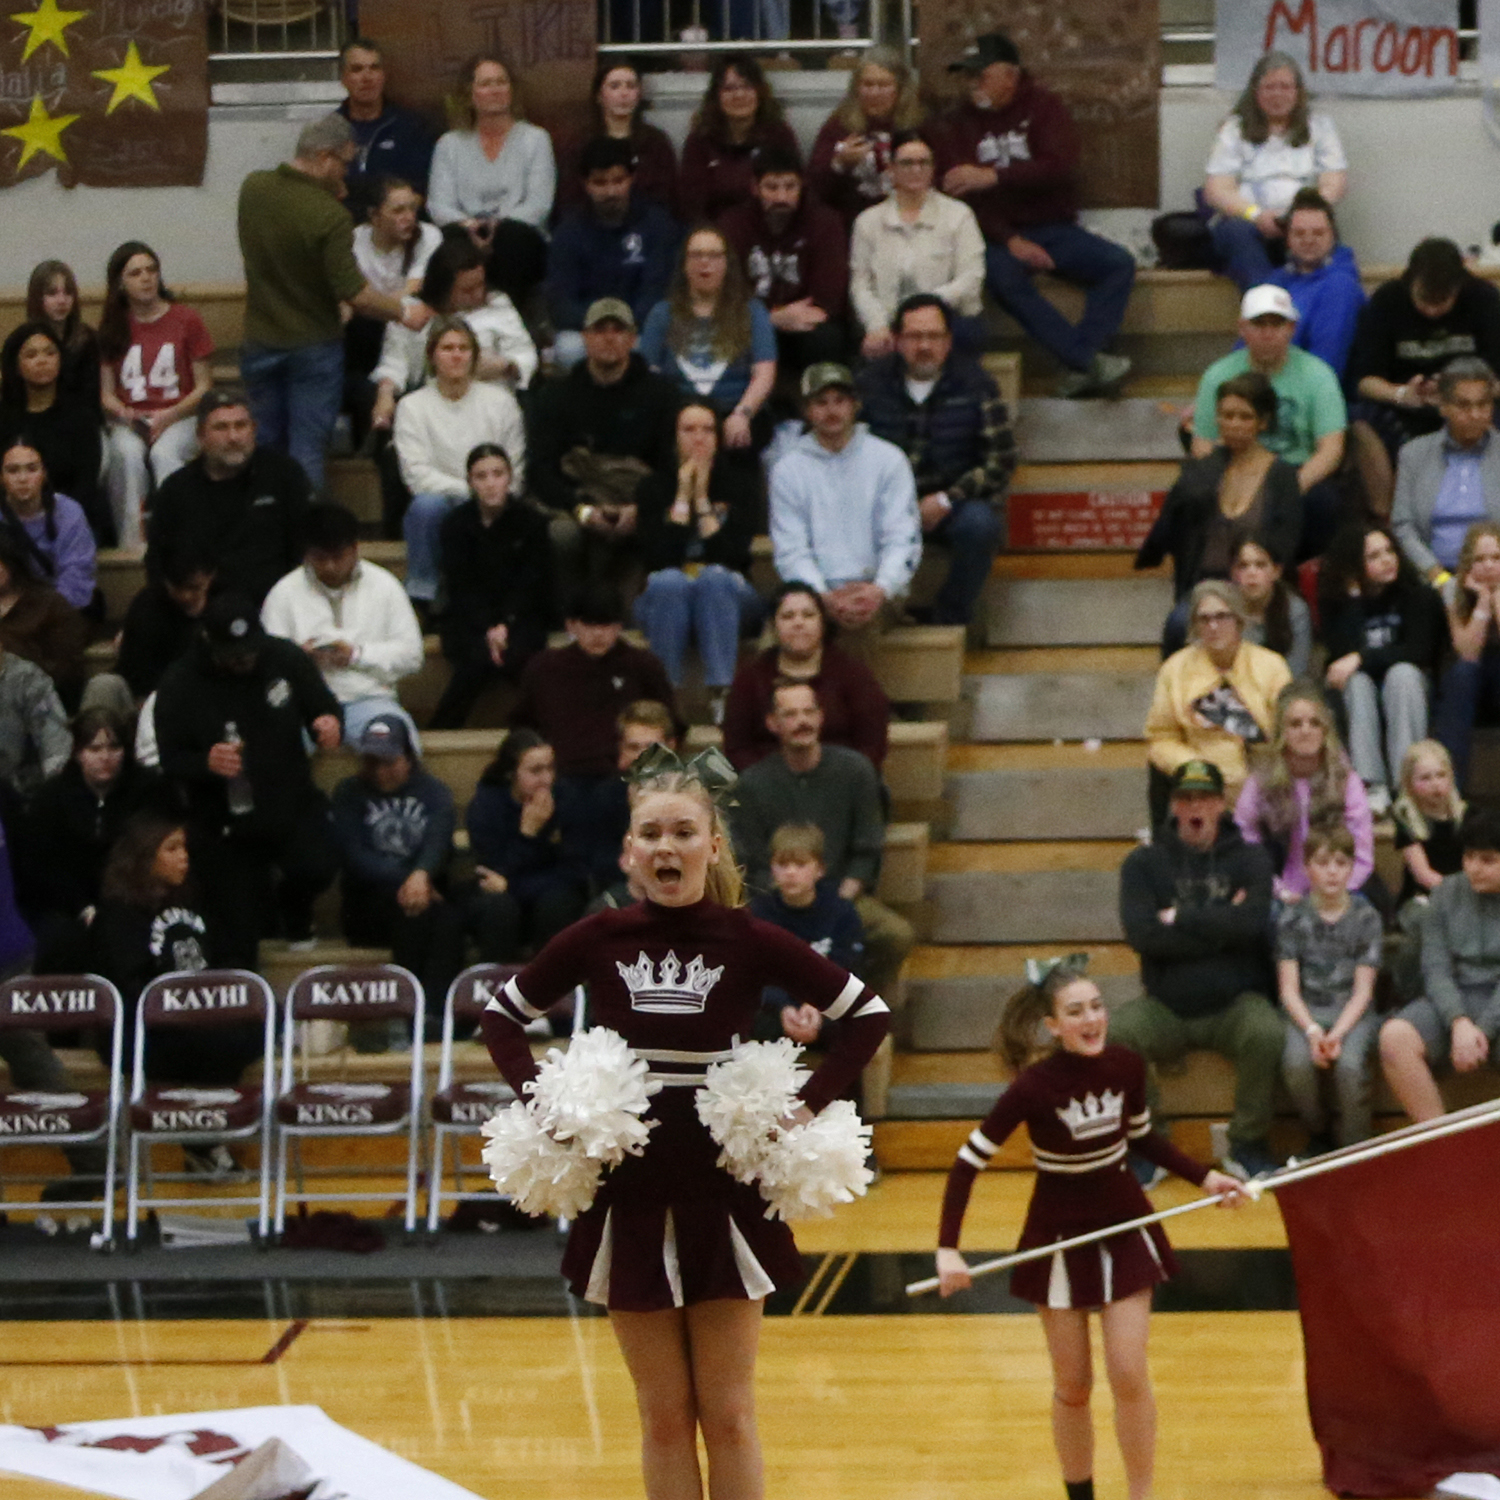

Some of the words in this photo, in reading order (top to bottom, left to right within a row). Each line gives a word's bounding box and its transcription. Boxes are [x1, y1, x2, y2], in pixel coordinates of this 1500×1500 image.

[1264, 0, 1460, 76] Maroon
[120, 342, 180, 402] 44
[11, 989, 97, 1013] KAYHI
[163, 983, 248, 1011] KAYHI
[311, 980, 398, 1005] KAYHI
[0, 1113, 72, 1134] KINGS
[151, 1110, 228, 1131] KINGS
[297, 1104, 374, 1123] KINGS
[451, 1102, 512, 1122] KIN
